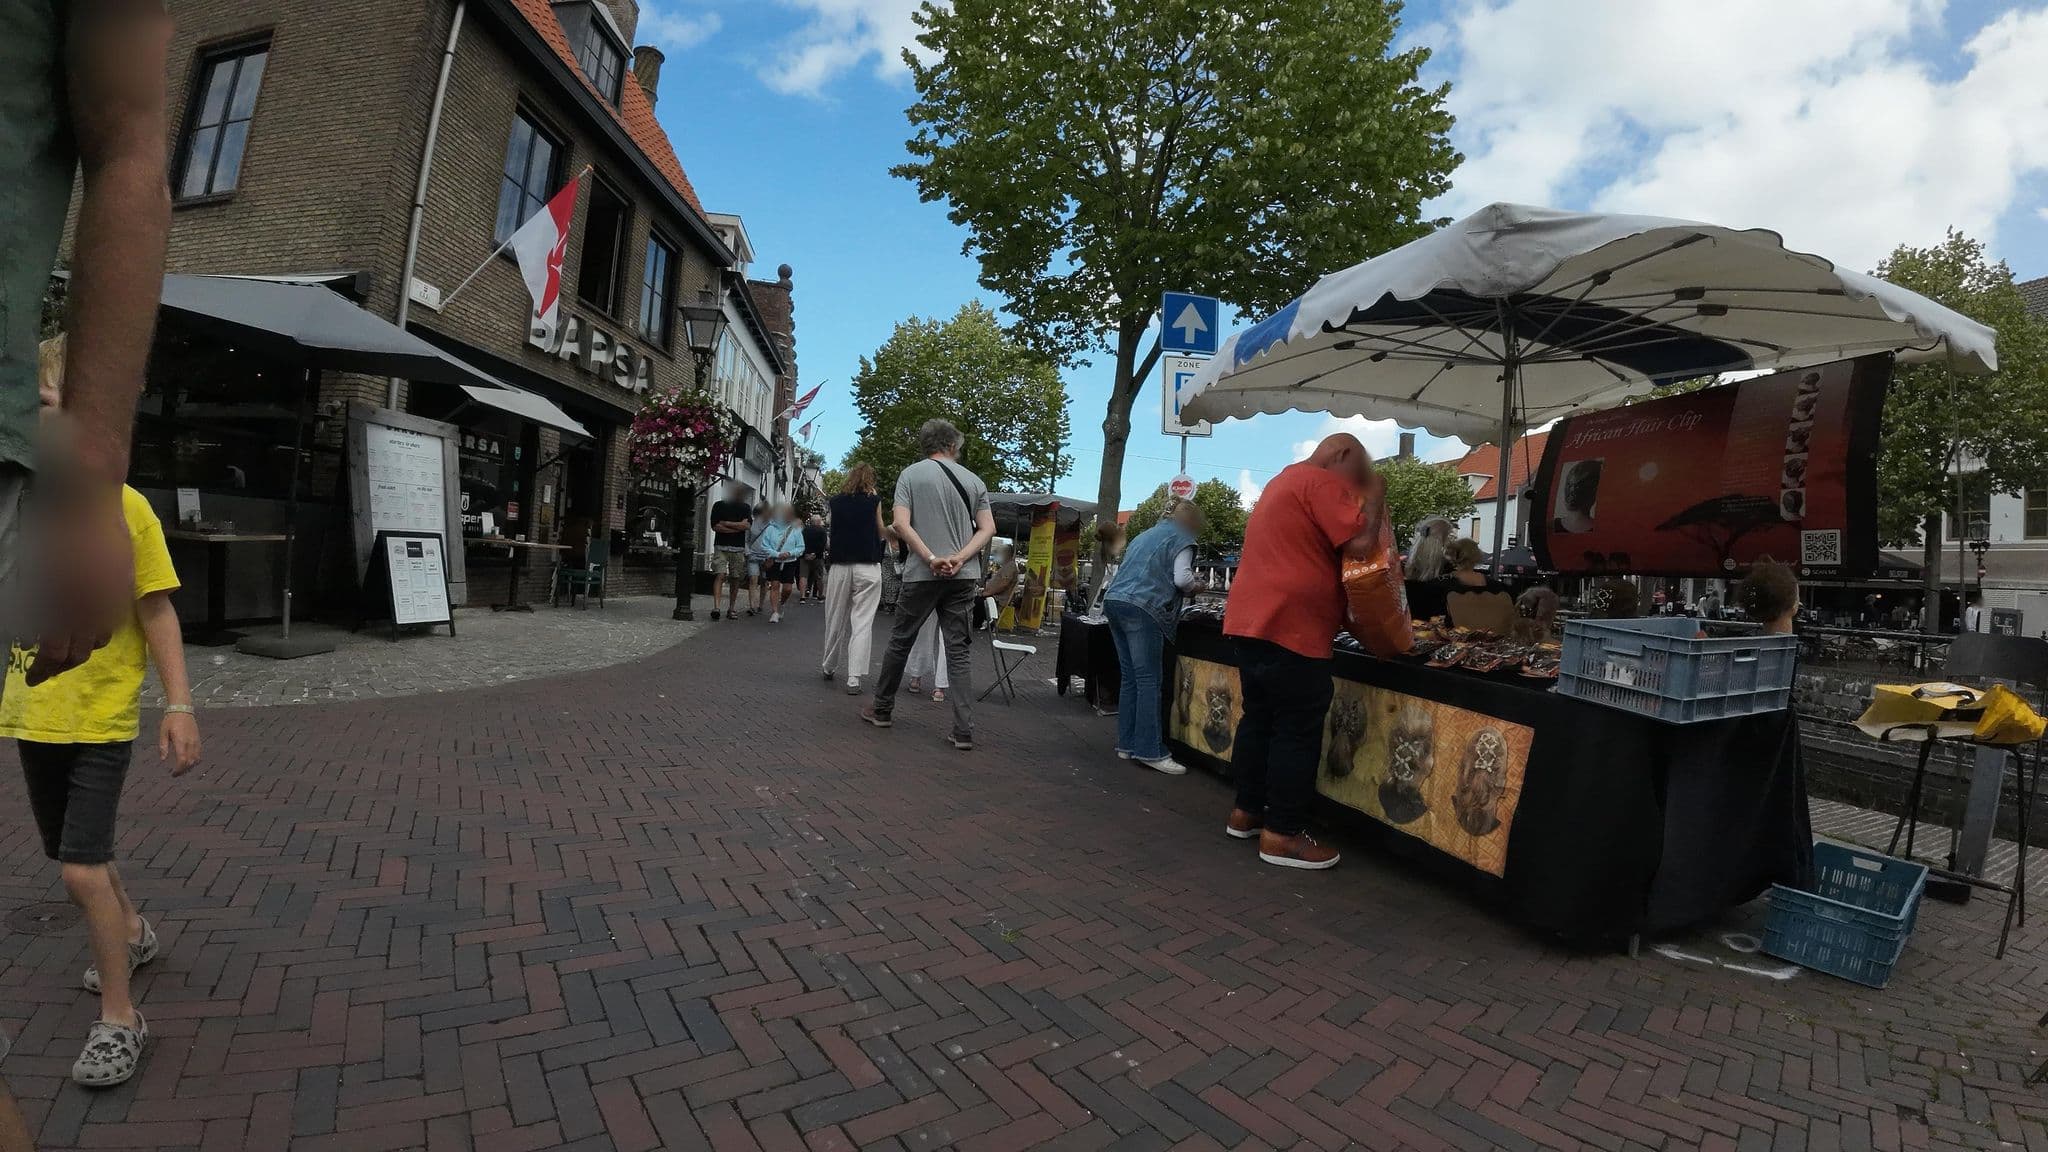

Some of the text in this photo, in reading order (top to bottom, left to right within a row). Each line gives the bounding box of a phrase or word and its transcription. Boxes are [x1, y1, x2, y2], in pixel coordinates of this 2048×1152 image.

[1177, 360, 1201, 369] ZONE
[1566, 427, 1623, 449] African
[1624, 415, 1666, 439] Hair
[1667, 409, 1703, 431] Clip
[460, 434, 500, 455] RSA
